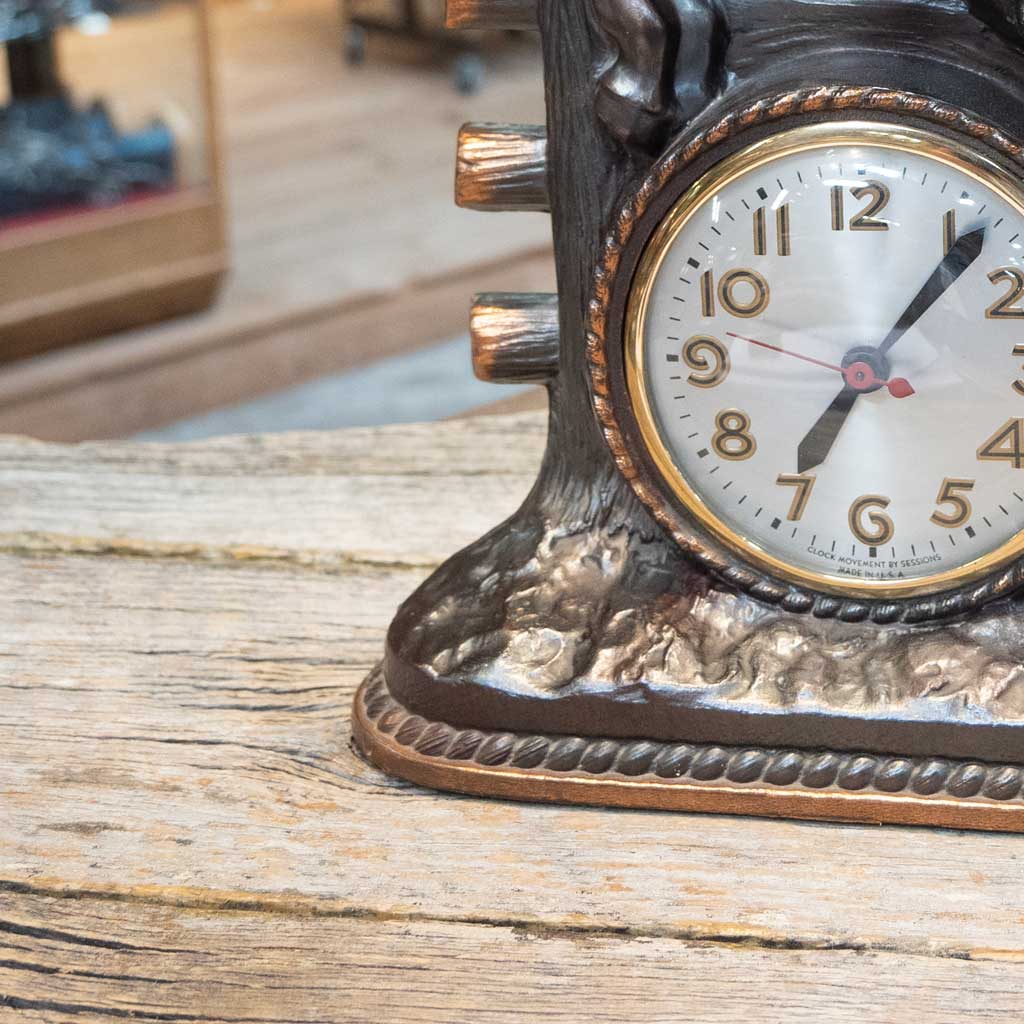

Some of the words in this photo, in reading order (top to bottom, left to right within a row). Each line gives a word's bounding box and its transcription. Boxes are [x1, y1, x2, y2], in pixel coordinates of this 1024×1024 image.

[753, 202, 790, 257] 11
[830, 179, 890, 231] 12
[700, 267, 770, 318] 10
[682, 334, 730, 388] 9
[711, 407, 757, 461] 8
[776, 473, 816, 521] 7
[847, 494, 894, 546] 6
[929, 477, 975, 528] 5
[807, 546, 836, 561] CLOCK
[837, 556, 885, 569] MOVEMENT
[888, 560, 899, 568] BY
[900, 553, 942, 568] SESSIONS
[837, 566, 861, 577] MADE
